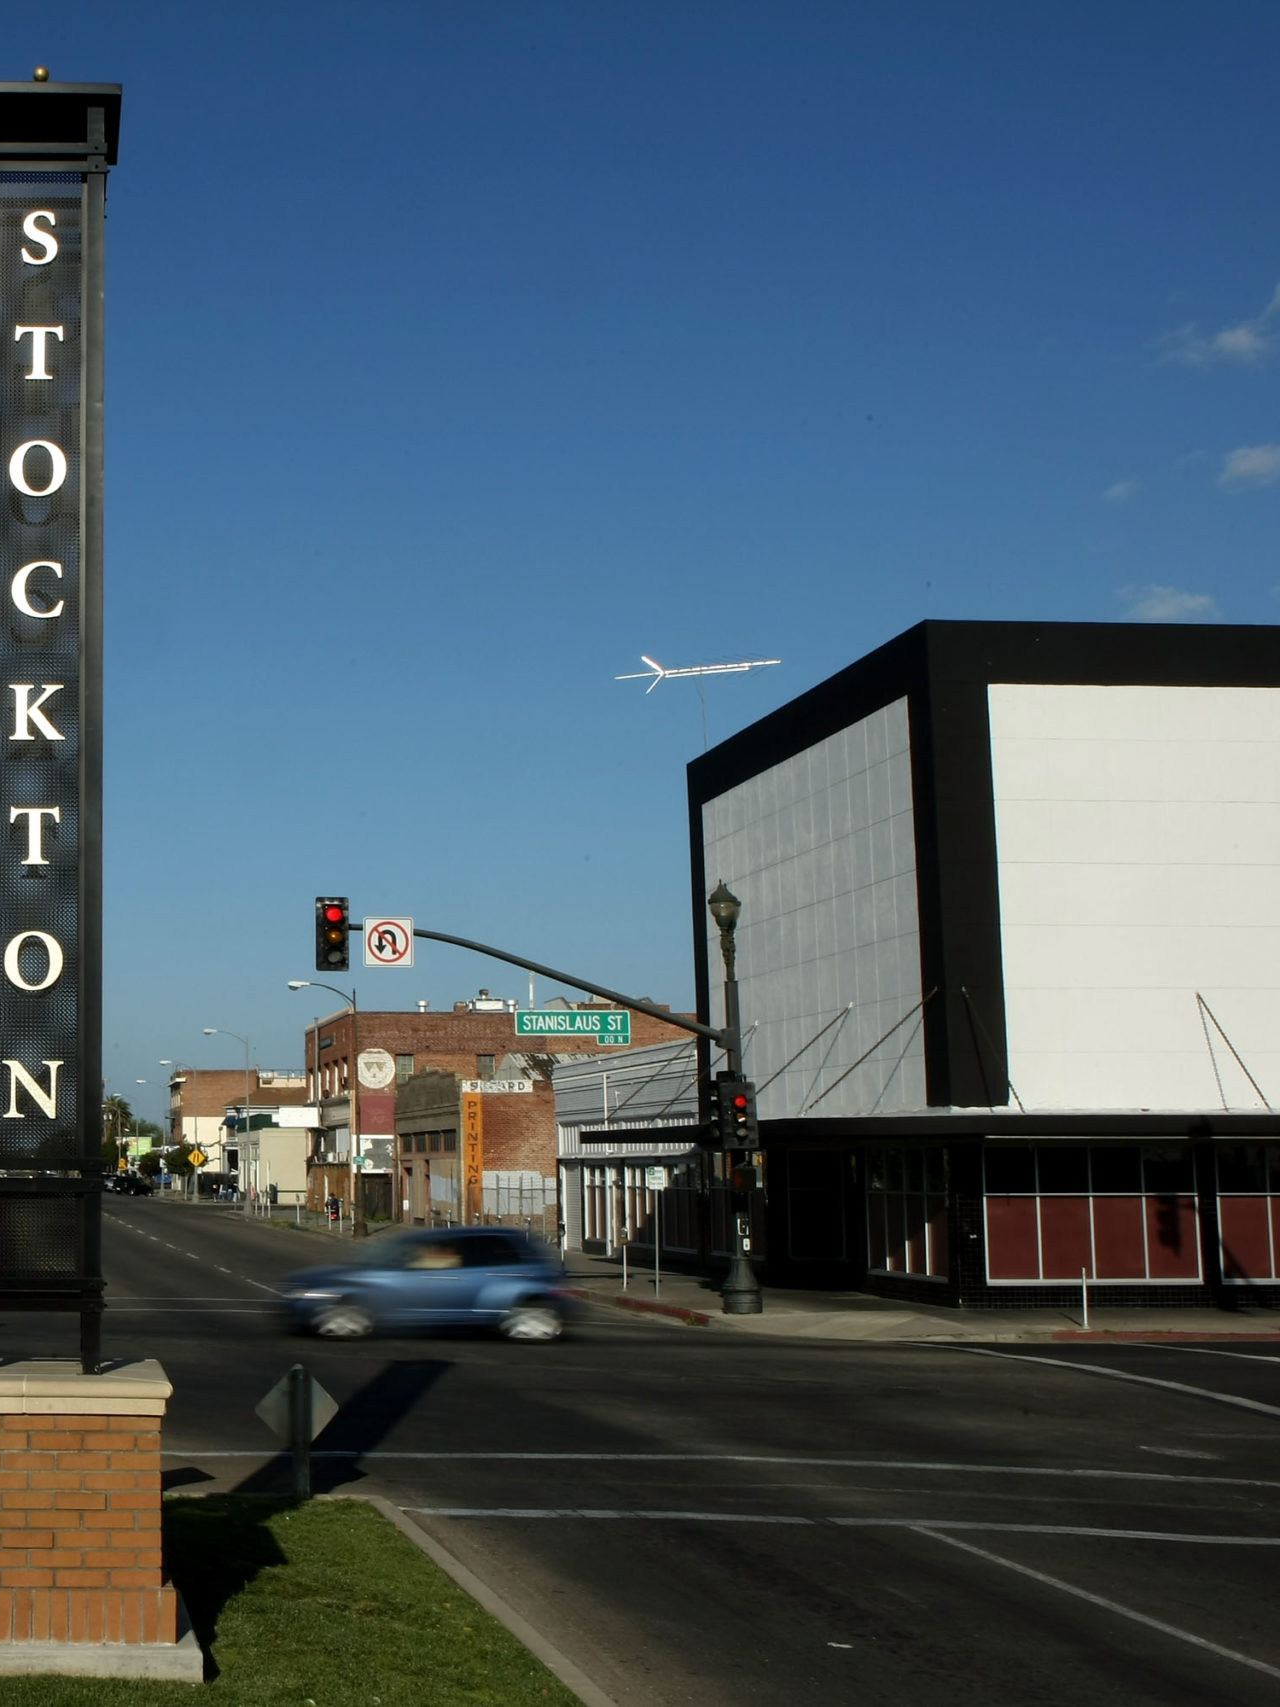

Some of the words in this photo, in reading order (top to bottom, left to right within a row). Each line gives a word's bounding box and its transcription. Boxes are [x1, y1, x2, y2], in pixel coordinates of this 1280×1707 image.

[2, 211, 67, 1119] STOCKTON
[523, 1015, 600, 1030] STANISLAUS
[608, 1015, 623, 1030] ST
[467, 1101, 479, 1185] PRINTING
